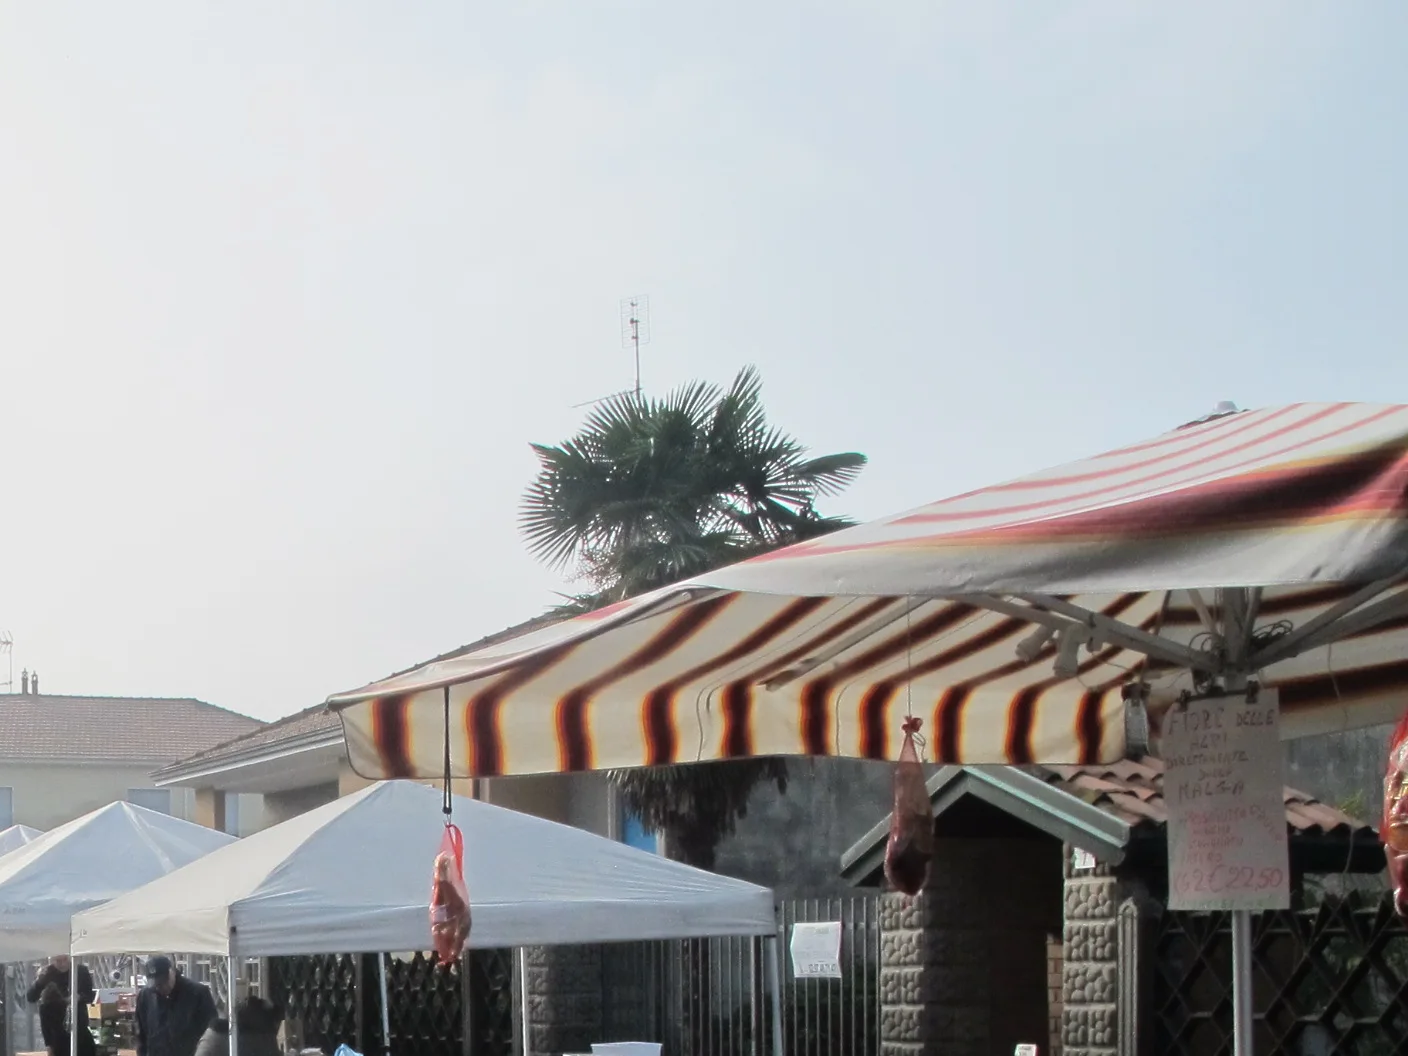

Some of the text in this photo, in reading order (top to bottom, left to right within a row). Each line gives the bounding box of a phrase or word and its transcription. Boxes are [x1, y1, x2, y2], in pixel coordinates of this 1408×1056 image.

[1168, 707, 1276, 735] FIORE DELLE
[1178, 780, 1245, 803] MALGA
